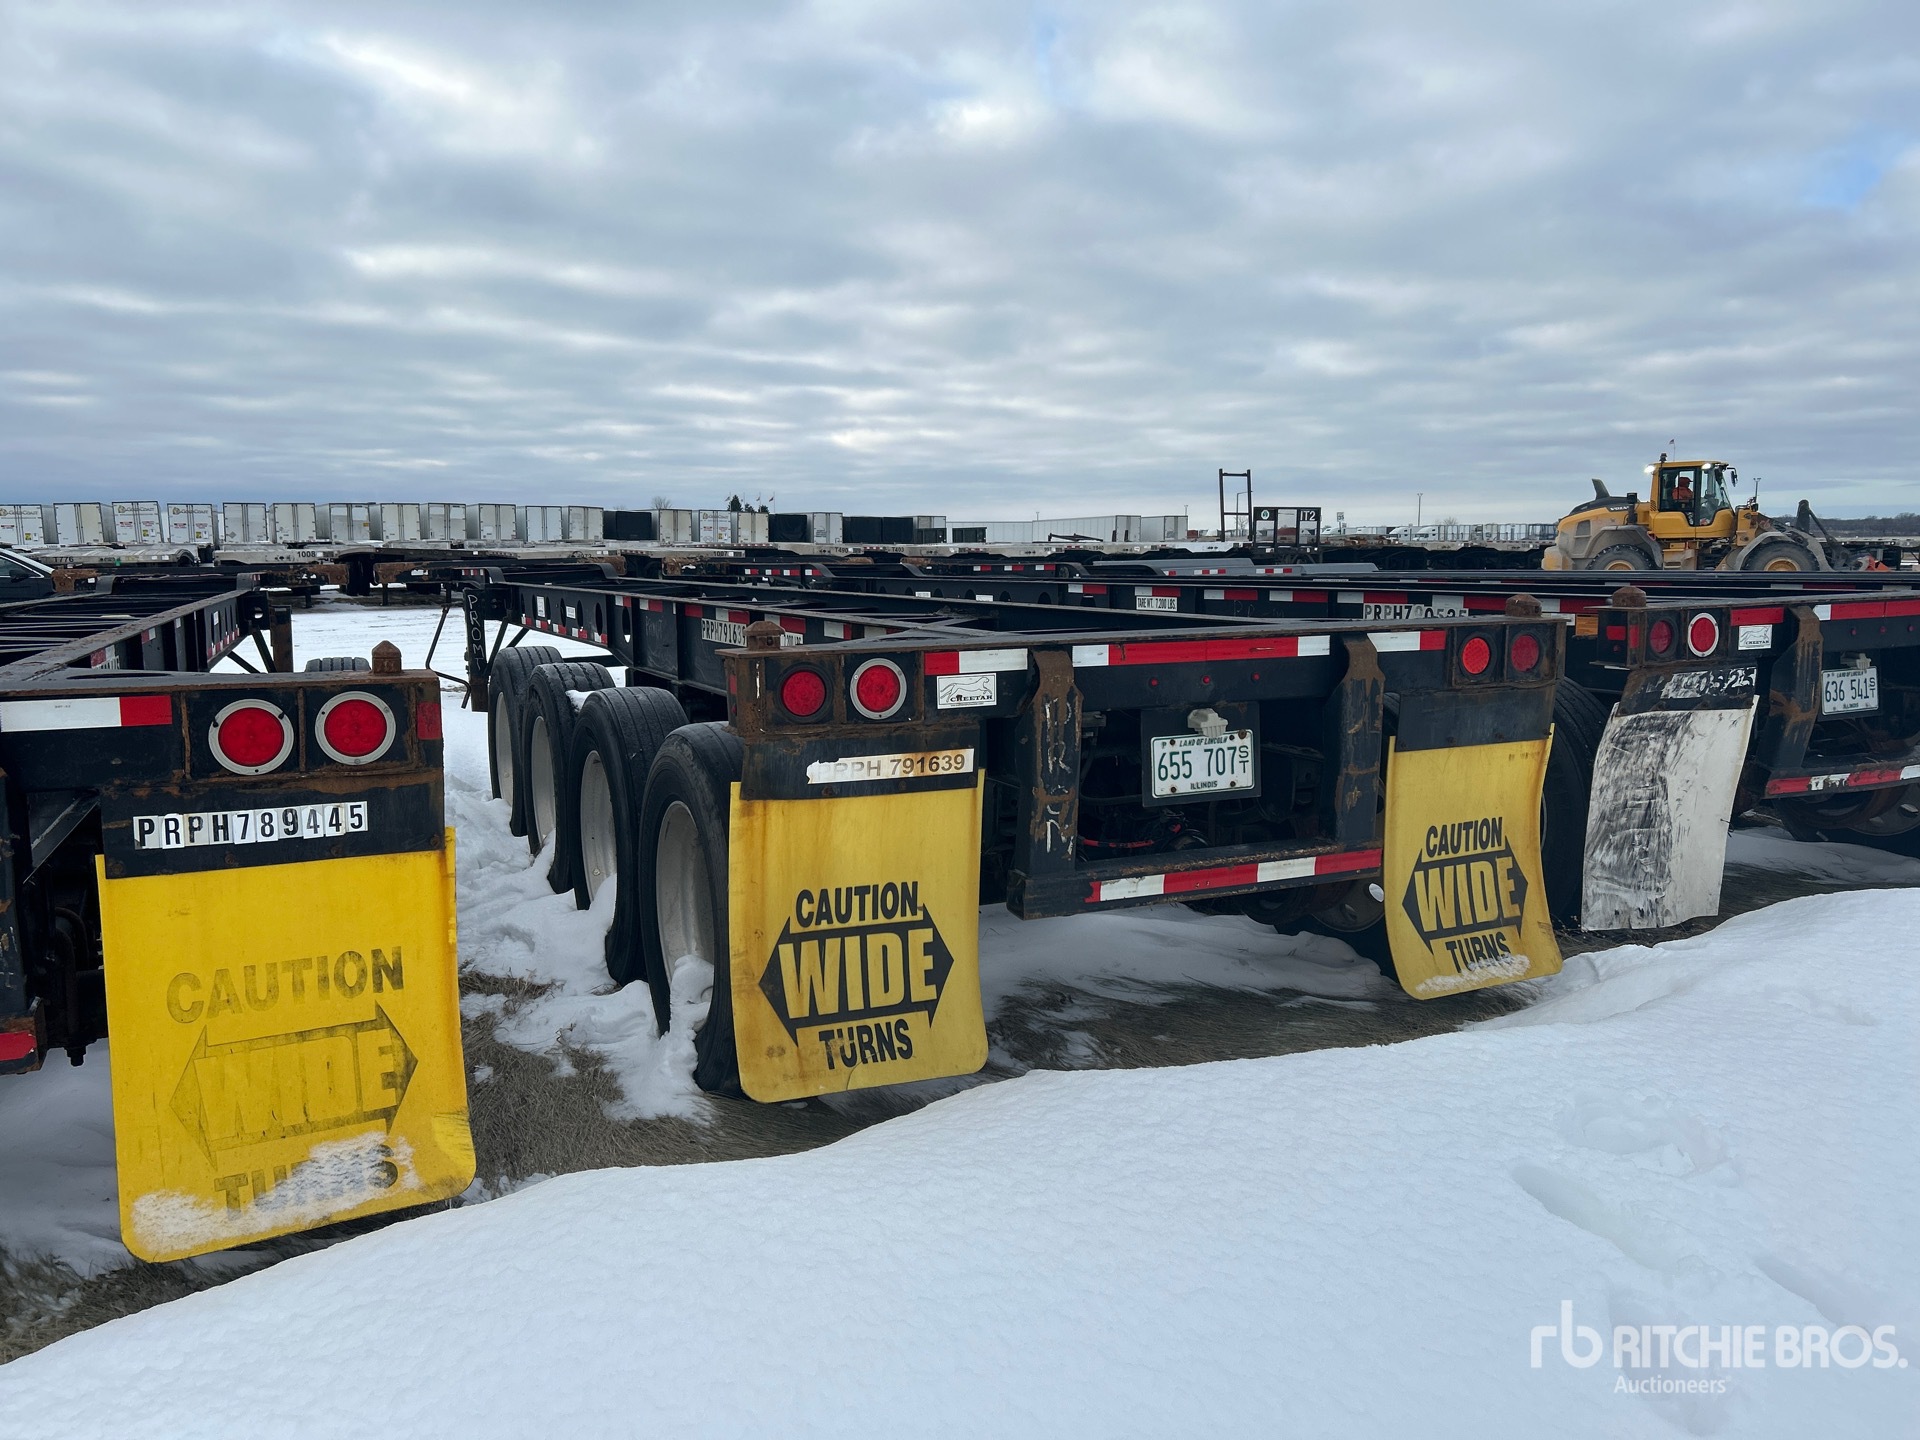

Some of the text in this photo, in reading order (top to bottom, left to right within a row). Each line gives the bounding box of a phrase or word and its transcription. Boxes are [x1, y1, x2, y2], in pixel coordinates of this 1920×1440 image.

[1825, 677, 1869, 702] 636 541
[1179, 739, 1195, 747] LAND
[1204, 736, 1228, 745] LINCOLN
[889, 753, 966, 776] 791639
[1158, 746, 1237, 781] 655 707
[1190, 780, 1218, 789] ILLINOIS
[138, 804, 363, 847] PRPH789445
[1426, 816, 1503, 858] CAUTION
[795, 881, 918, 928] CAUTION
[1414, 856, 1521, 933] WIDE
[166, 945, 405, 1024] CAUTION
[777, 927, 938, 1019] WIDE
[818, 1018, 914, 1070] TURNS
[193, 1027, 398, 1143] WIDE
